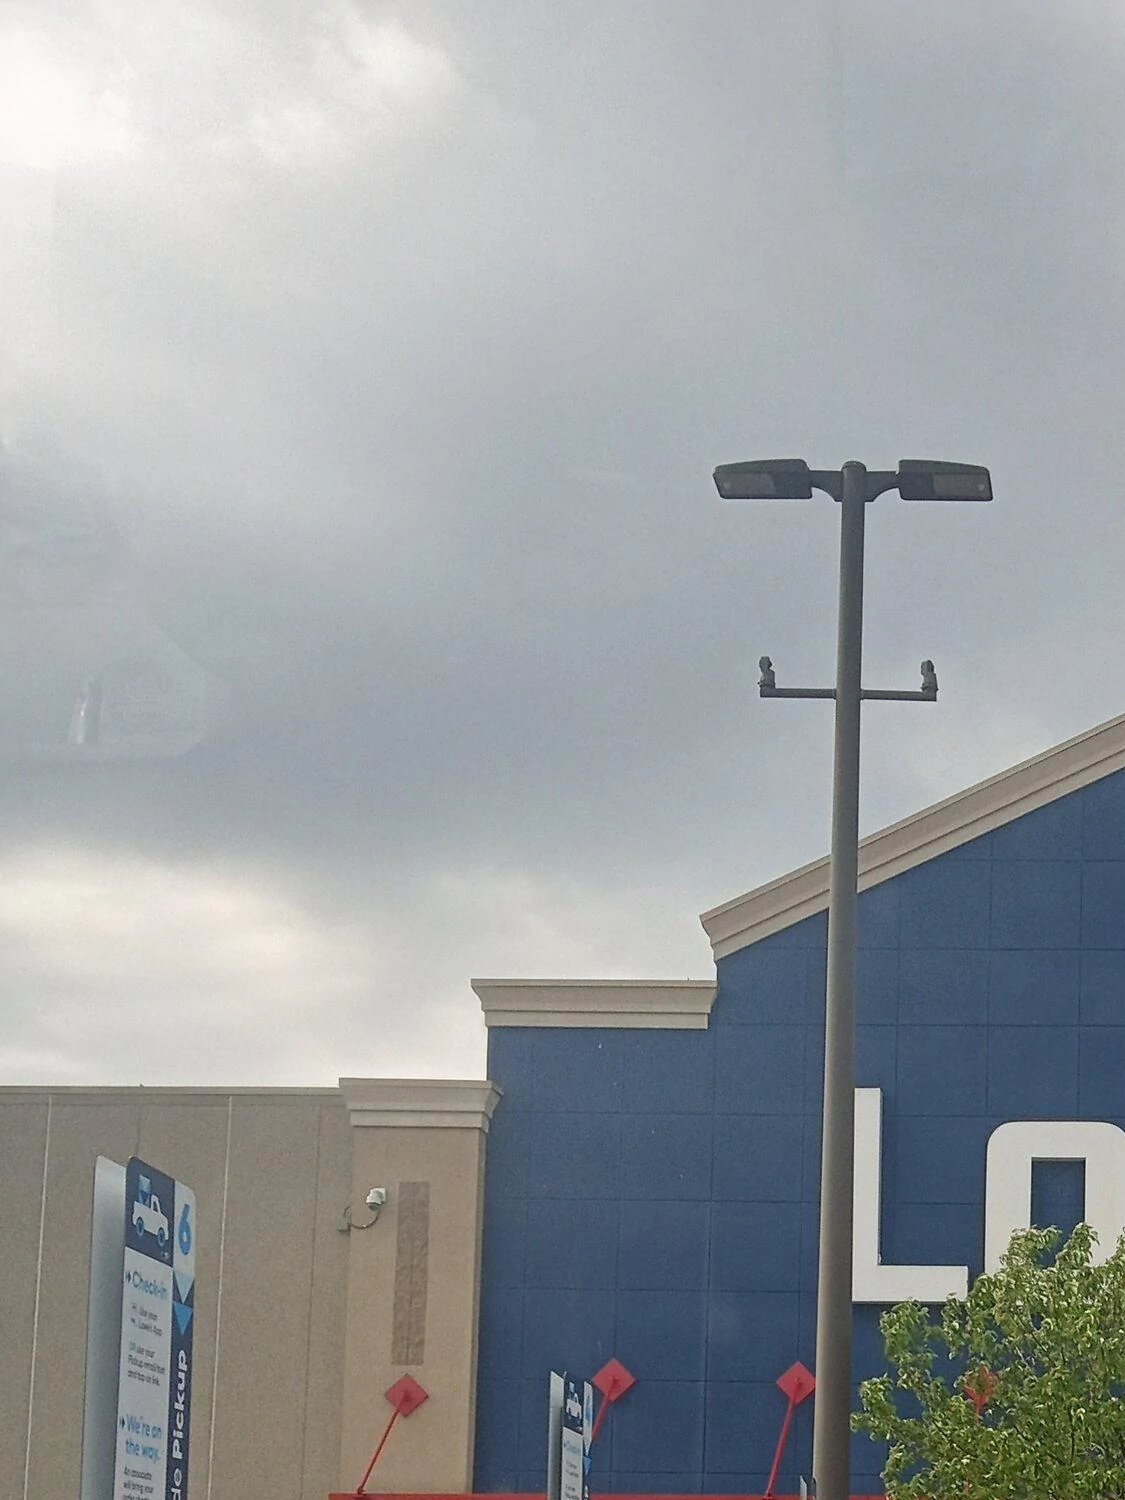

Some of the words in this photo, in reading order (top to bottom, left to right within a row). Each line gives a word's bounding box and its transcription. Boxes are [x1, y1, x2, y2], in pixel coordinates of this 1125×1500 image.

[178, 1203, 191, 1256] 6
[132, 1270, 167, 1301] Check-in
[172, 1350, 187, 1459] Pickup
[126, 1414, 150, 1437] We're
[151, 1425, 162, 1439] on
[126, 1439, 140, 1456] the
